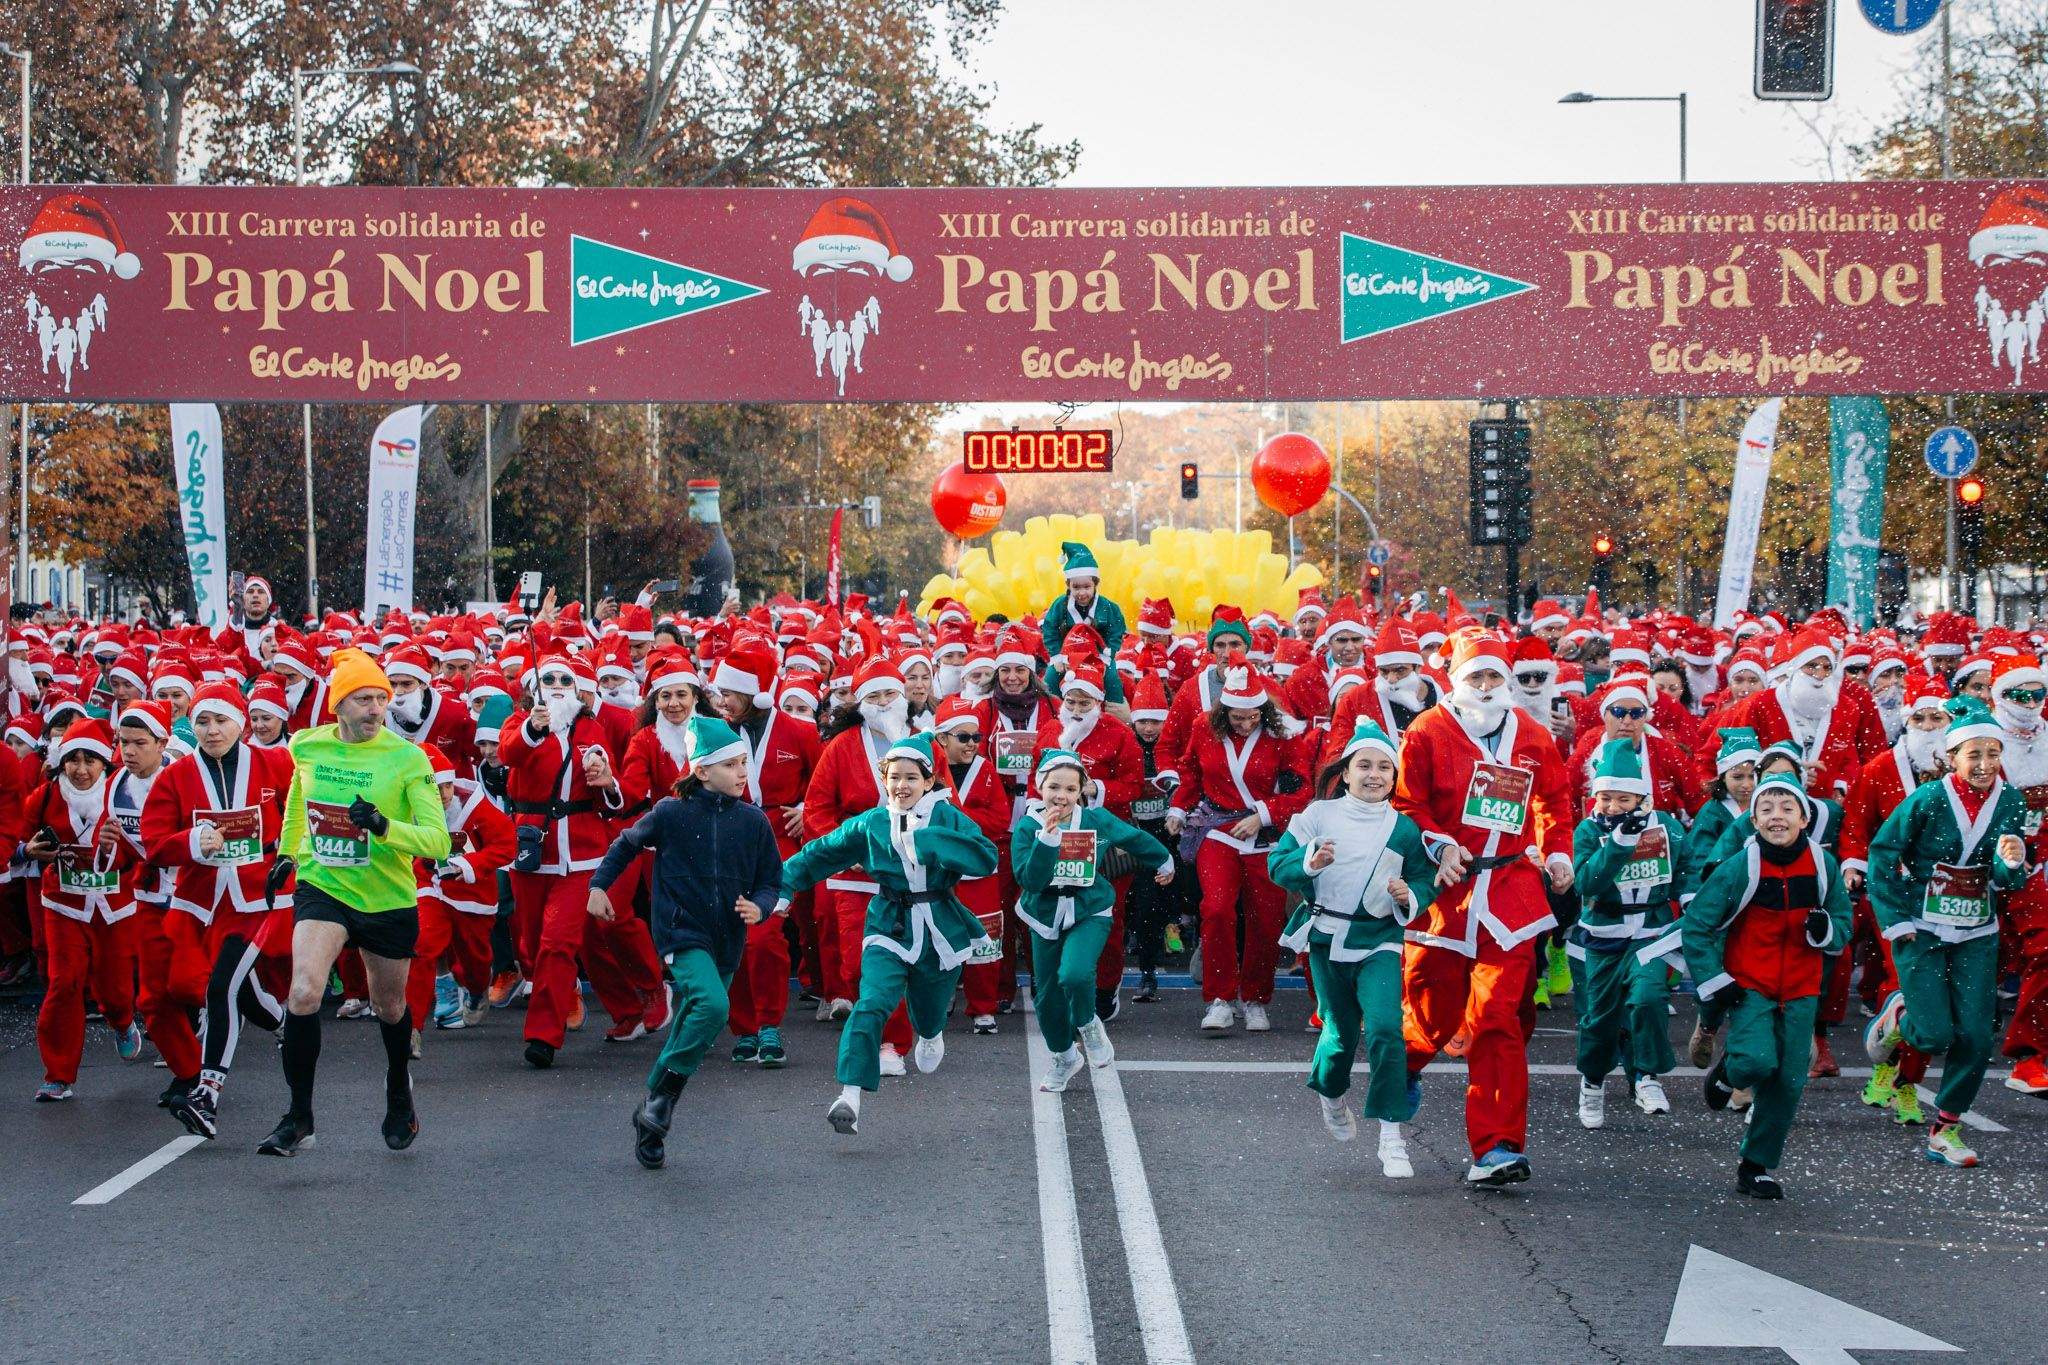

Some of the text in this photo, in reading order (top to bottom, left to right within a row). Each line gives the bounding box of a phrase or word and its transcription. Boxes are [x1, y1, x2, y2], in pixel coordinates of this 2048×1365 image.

[166, 211, 546, 238] XIII Carrera solidaria de
[939, 210, 1316, 238] XIII Carrera solidaria de
[1567, 205, 1945, 234] XIII Carrera solidaria de
[164, 248, 550, 331] Papá Noel
[576, 271, 721, 306] El Corte Inglés
[935, 248, 1320, 332] Papá Noel
[1346, 267, 1491, 303] El Corte Inglés
[1563, 242, 1947, 328] Papá Noel
[249, 340, 462, 391] El Corte Inglés
[1021, 340, 1233, 392] El Corte Inglés
[1649, 334, 1863, 386] El Corte Inglés
[968, 433, 1107, 470] 00:00:02
[1135, 800, 1164, 813] 8908
[1481, 798, 1520, 823] 6424
[315, 836, 356, 857] 8444
[1620, 859, 1659, 881] 2888
[1939, 896, 1981, 916] 5303
